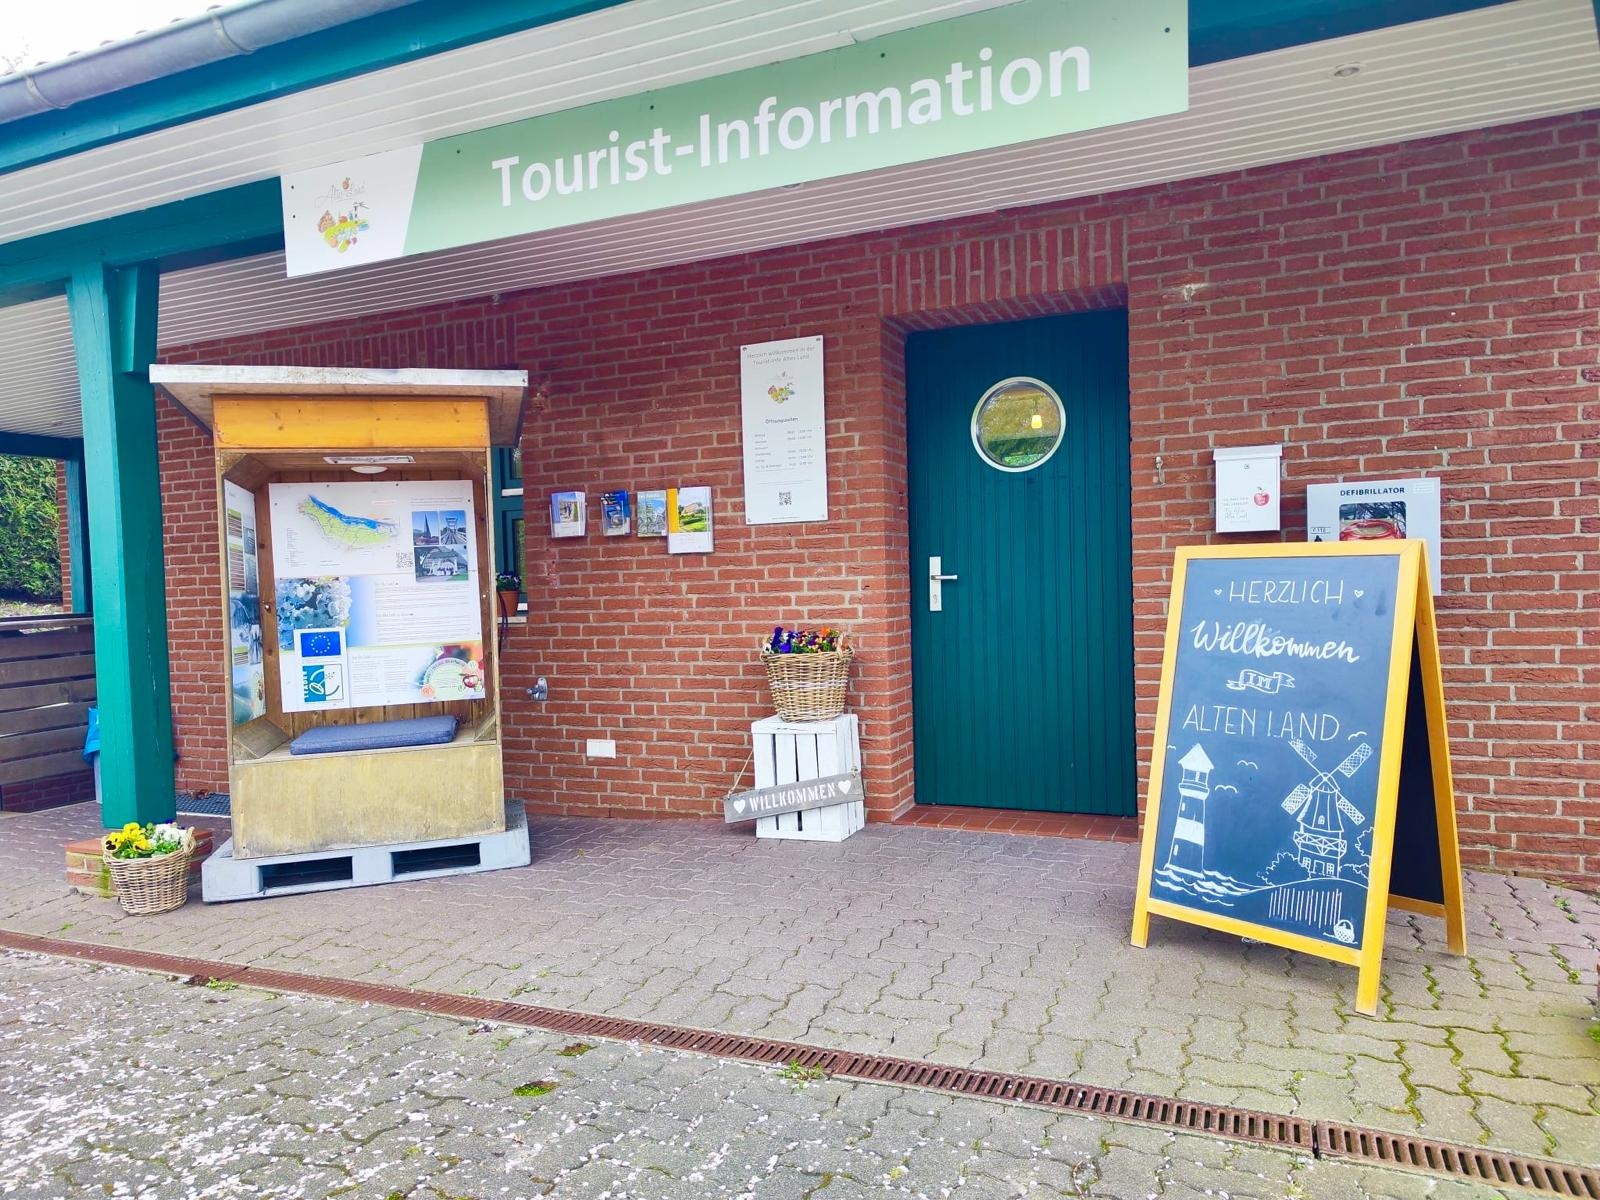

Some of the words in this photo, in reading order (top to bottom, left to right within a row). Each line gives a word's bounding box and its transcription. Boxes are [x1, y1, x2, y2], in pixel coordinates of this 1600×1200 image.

[491, 45, 1092, 207] Tourist-Information
[1340, 487, 1405, 497] DEFIBRILLATOR
[1229, 580, 1344, 604] HERZLICH
[1190, 620, 1360, 663] Willkommen
[1247, 672, 1272, 690] IM
[1182, 704, 1256, 736] ALTEN
[1266, 711, 1340, 741] LAND
[749, 782, 836, 812] WILLKOMMEN
